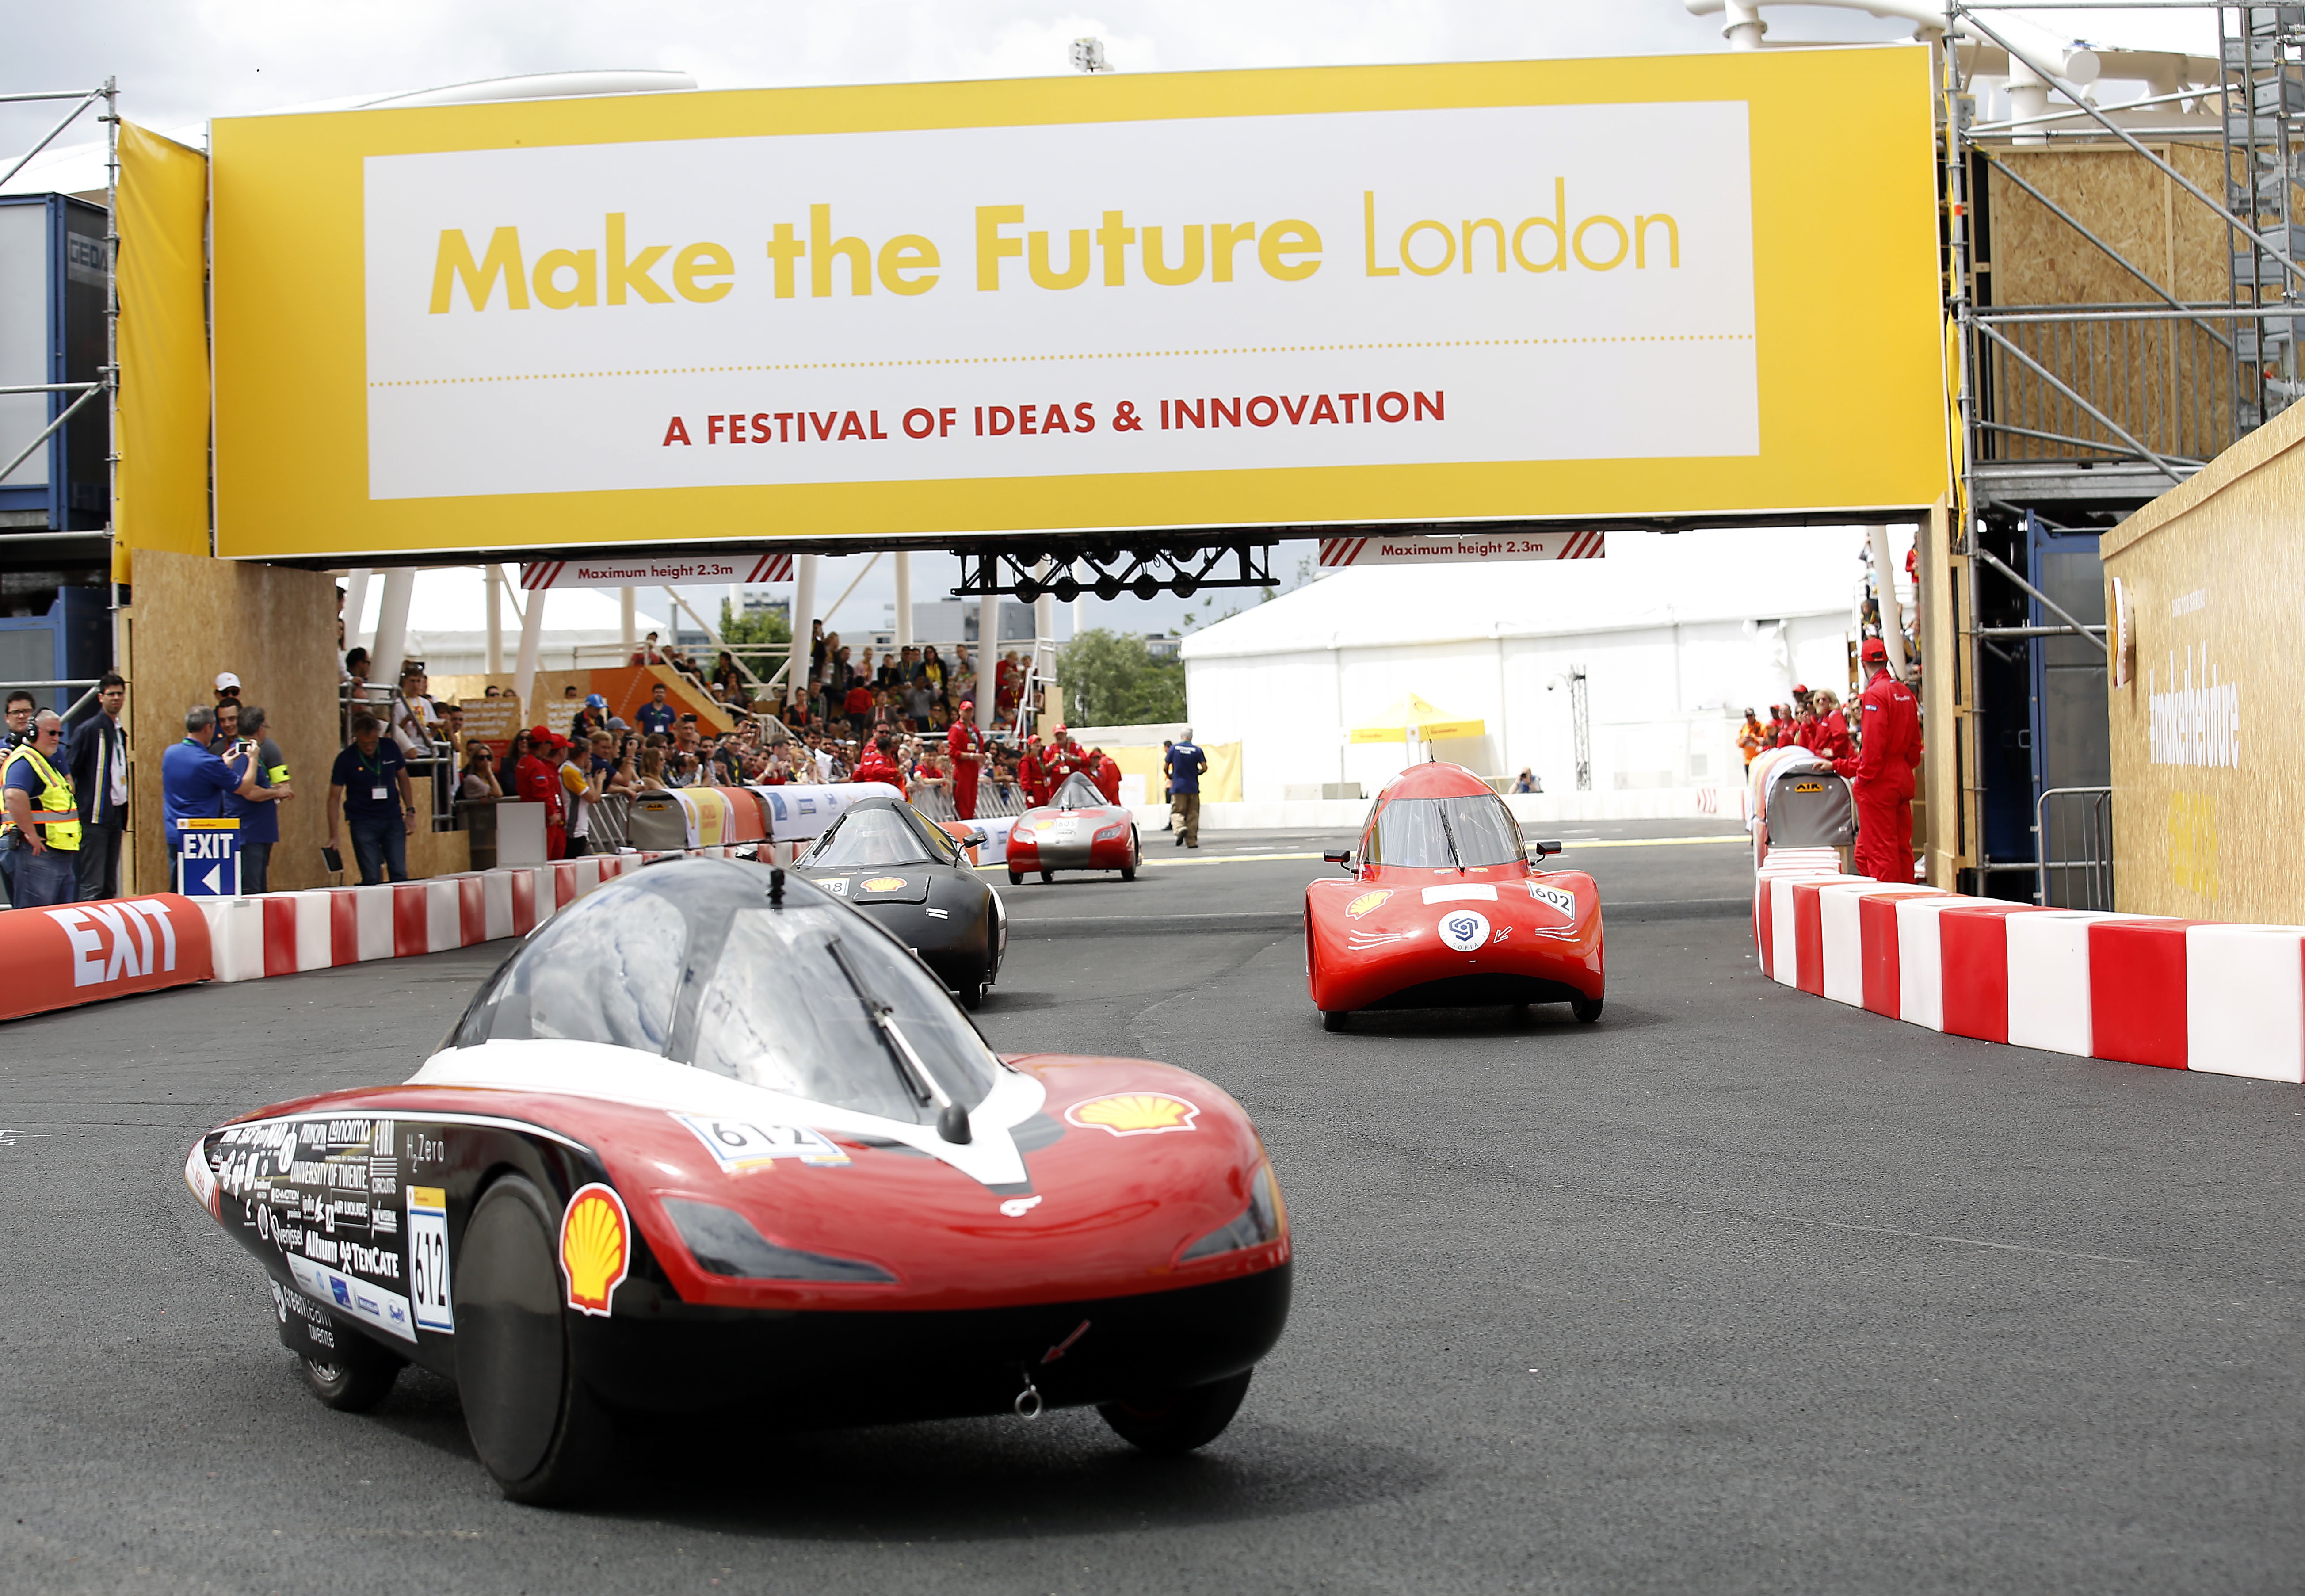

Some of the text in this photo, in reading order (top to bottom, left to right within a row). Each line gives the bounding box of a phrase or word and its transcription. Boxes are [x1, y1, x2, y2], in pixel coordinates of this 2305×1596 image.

[429, 176, 1680, 314] Make the Future London
[663, 391, 1444, 446] A FESTIVAL OF IDEAS & INNOVATION
[1381, 541, 1543, 556] Maximum height 2.3m
[579, 564, 733, 579] Maximum height 2.3m
[2149, 640, 2240, 769] #makethefuture
[183, 833, 234, 859] EXIT
[1535, 887, 1570, 912] 602
[43, 899, 176, 988] EXIT
[712, 1122, 818, 1147] 612
[290, 1160, 328, 1186] UNIVERSITY
[328, 1163, 339, 1187] OF
[334, 1200, 344, 1215] AIR
[416, 1231, 446, 1306] 612
